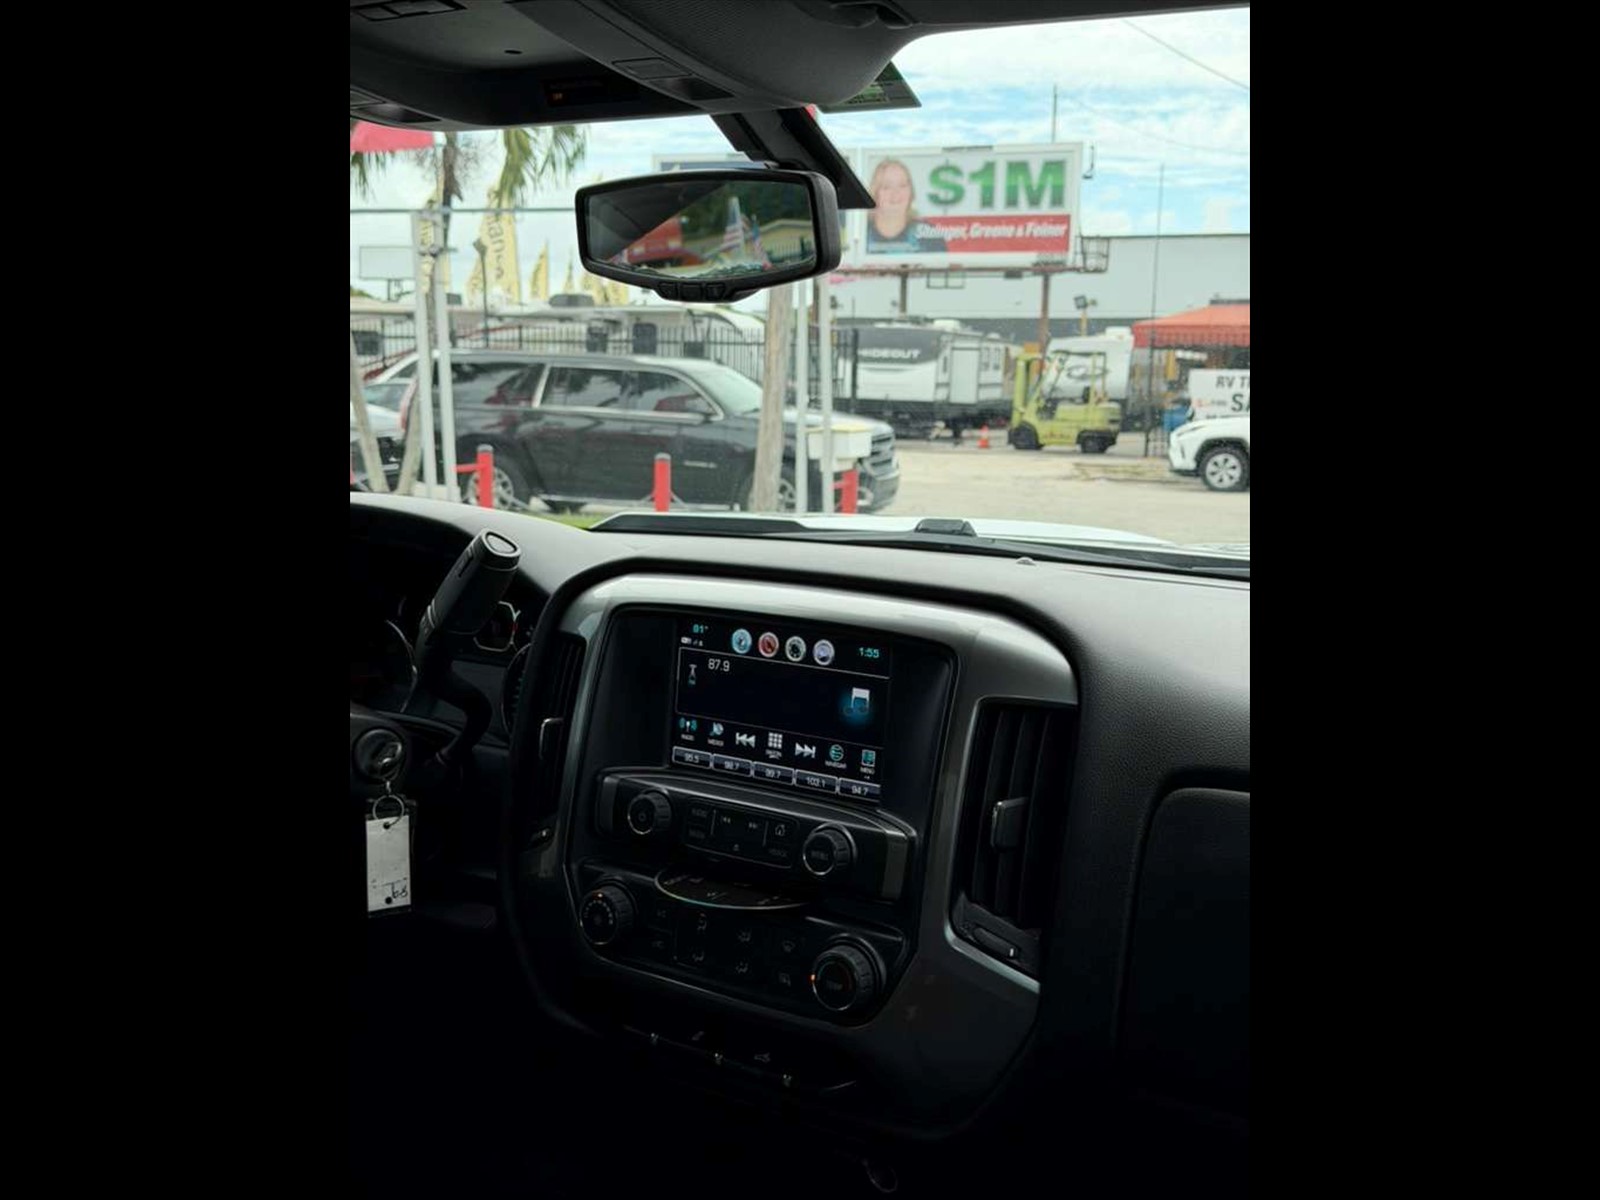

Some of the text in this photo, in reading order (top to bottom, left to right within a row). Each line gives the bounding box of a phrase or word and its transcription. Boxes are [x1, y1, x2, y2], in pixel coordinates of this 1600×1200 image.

[927, 158, 1066, 213] $1M
[970, 222, 1014, 238] Greene
[1215, 375, 1250, 388] RV T
[1231, 393, 1250, 413] S
[859, 647, 880, 659] 1:55
[708, 658, 730, 673] 87.9
[851, 784, 869, 796] 94.7
